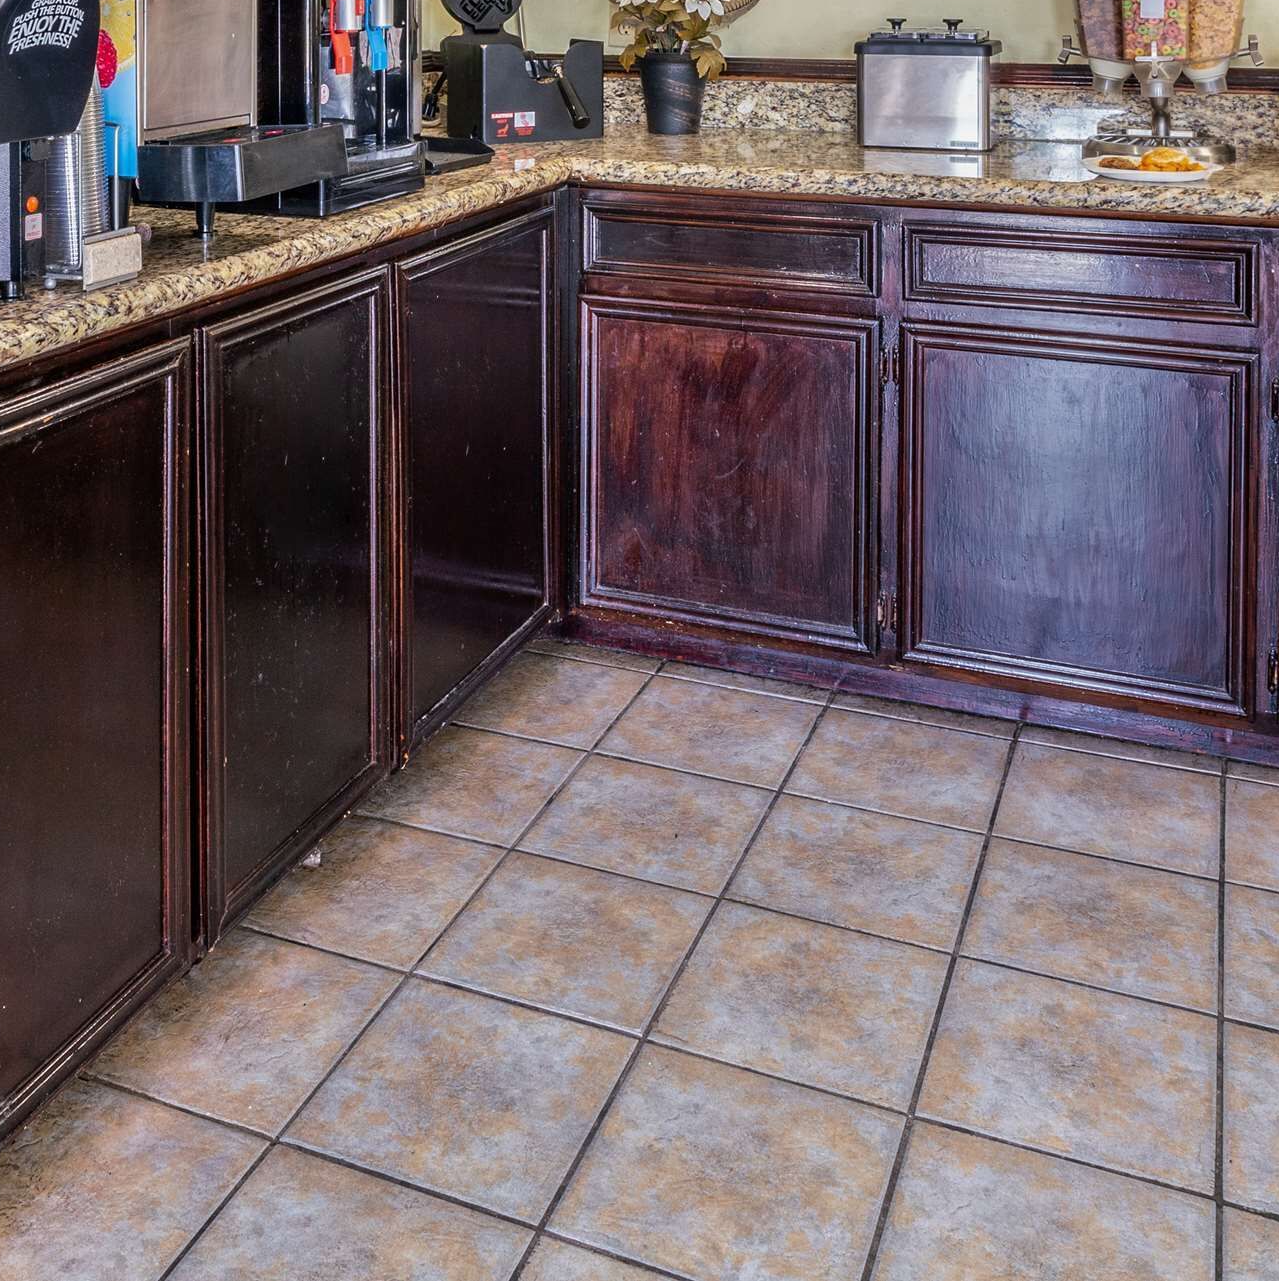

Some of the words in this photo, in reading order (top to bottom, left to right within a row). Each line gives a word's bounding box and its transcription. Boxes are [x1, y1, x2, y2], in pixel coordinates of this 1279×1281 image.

[12, 8, 39, 27] PUSH
[39, 4, 56, 17] THE
[7, 15, 59, 45] ENJOY
[58, 15, 82, 38] THE
[8, 31, 73, 55] FRESHNESS!
